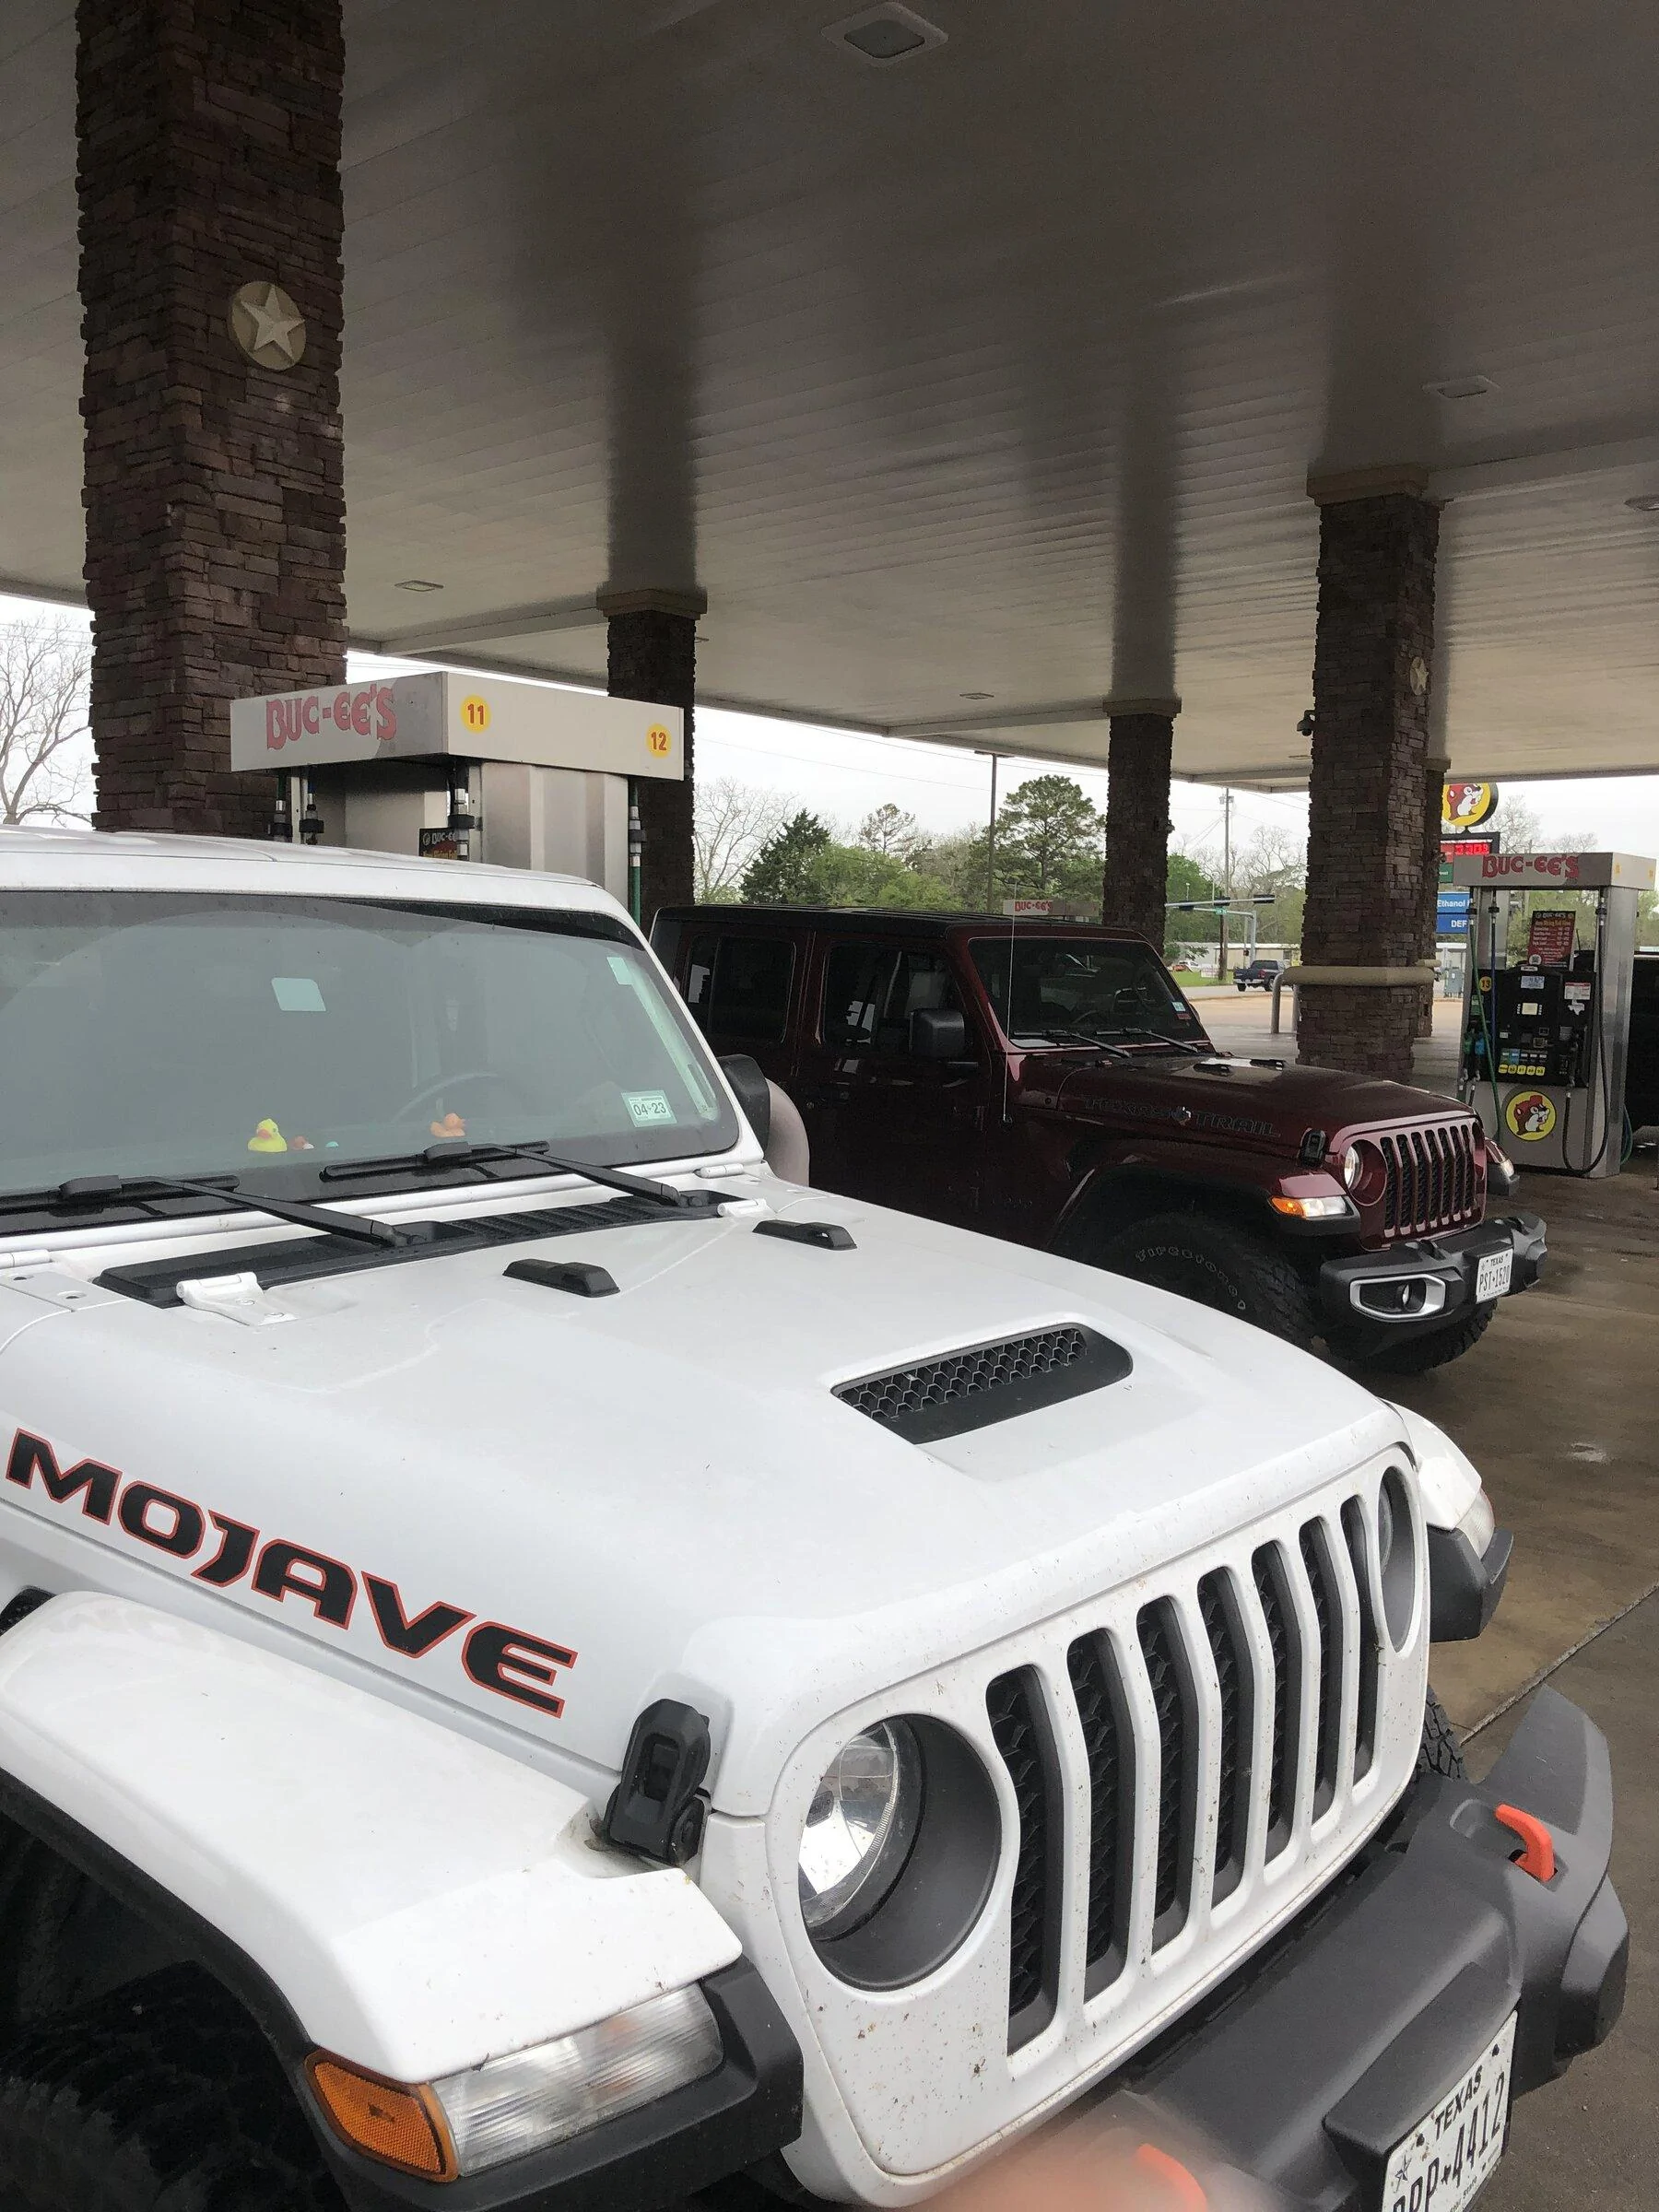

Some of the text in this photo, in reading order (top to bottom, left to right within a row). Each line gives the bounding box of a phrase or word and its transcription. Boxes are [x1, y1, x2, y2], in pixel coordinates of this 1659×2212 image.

[467, 703, 485, 725] 11
[651, 731, 667, 751] 12
[1437, 900, 1465, 908] Ethanol
[1451, 920, 1468, 928] DEF
[1490, 1254, 1504, 1267] TEXAS
[6, 1428, 579, 1720] MOJAVE
[1434, 2065, 1483, 2142] TEXAS
